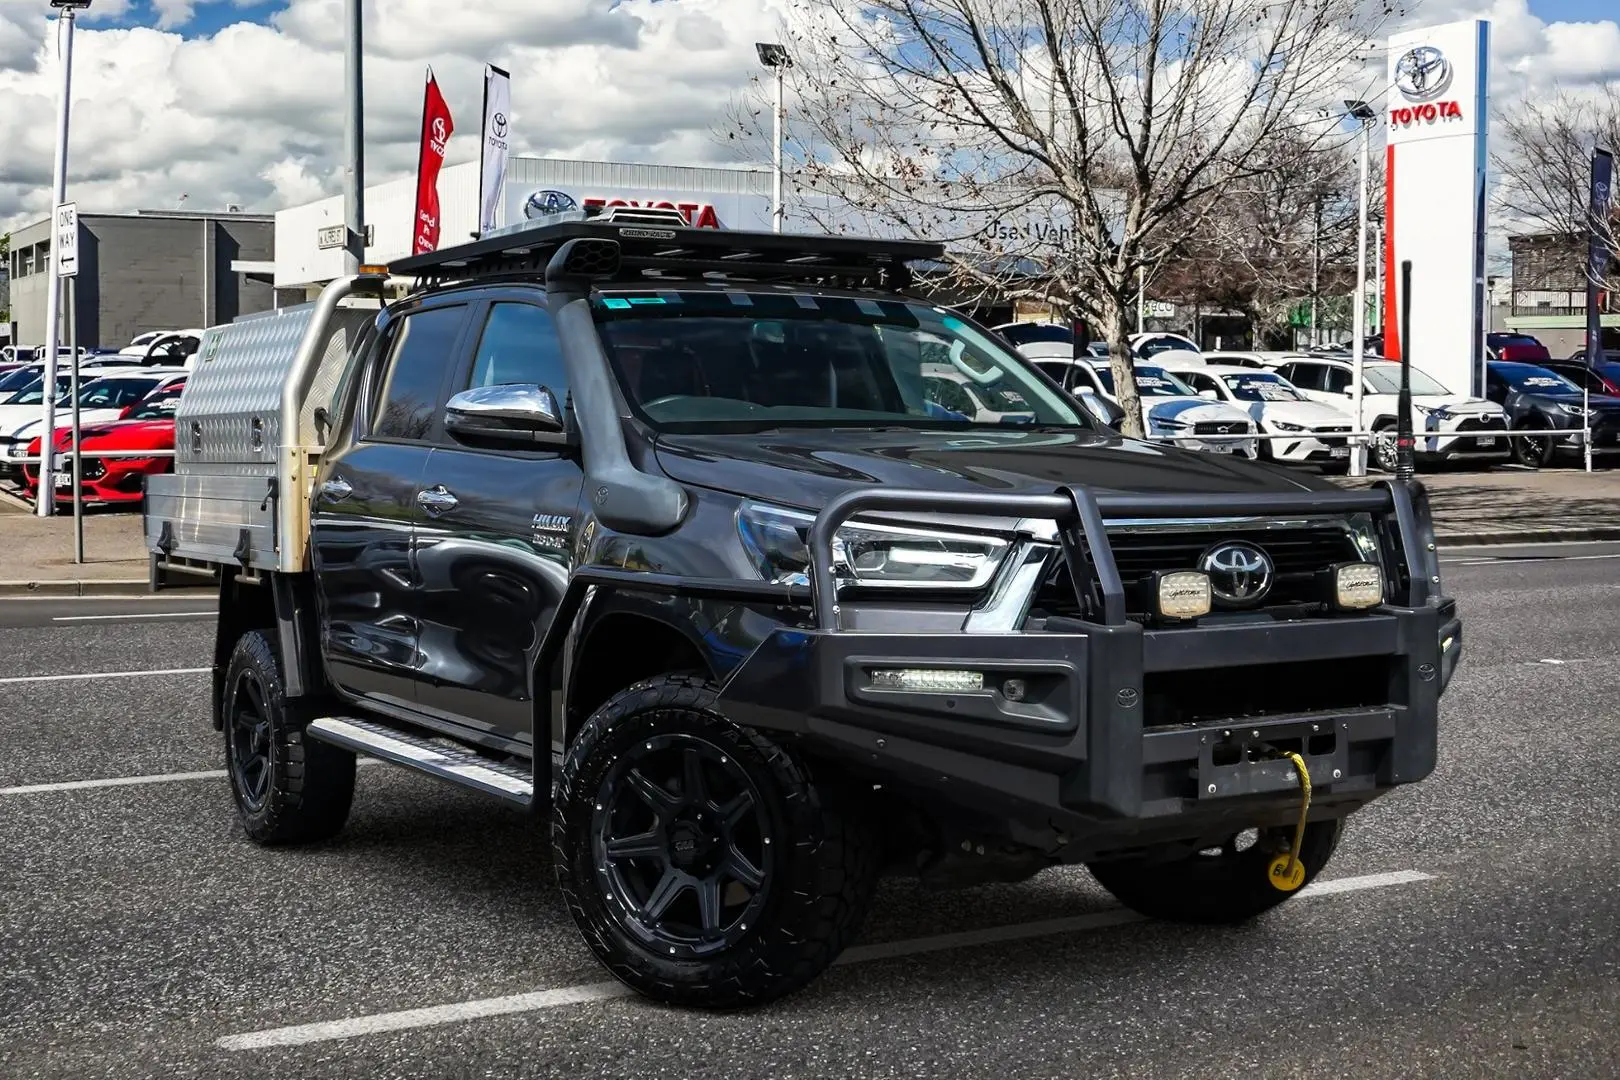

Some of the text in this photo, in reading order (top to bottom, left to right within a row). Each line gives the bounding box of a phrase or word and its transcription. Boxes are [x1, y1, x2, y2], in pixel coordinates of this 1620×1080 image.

[1389, 101, 1463, 124] TOYOTA
[488, 136, 508, 150] TOYOTA
[60, 208, 74, 228] ONE
[59, 231, 75, 249] WAY
[985, 220, 1030, 240] Used
